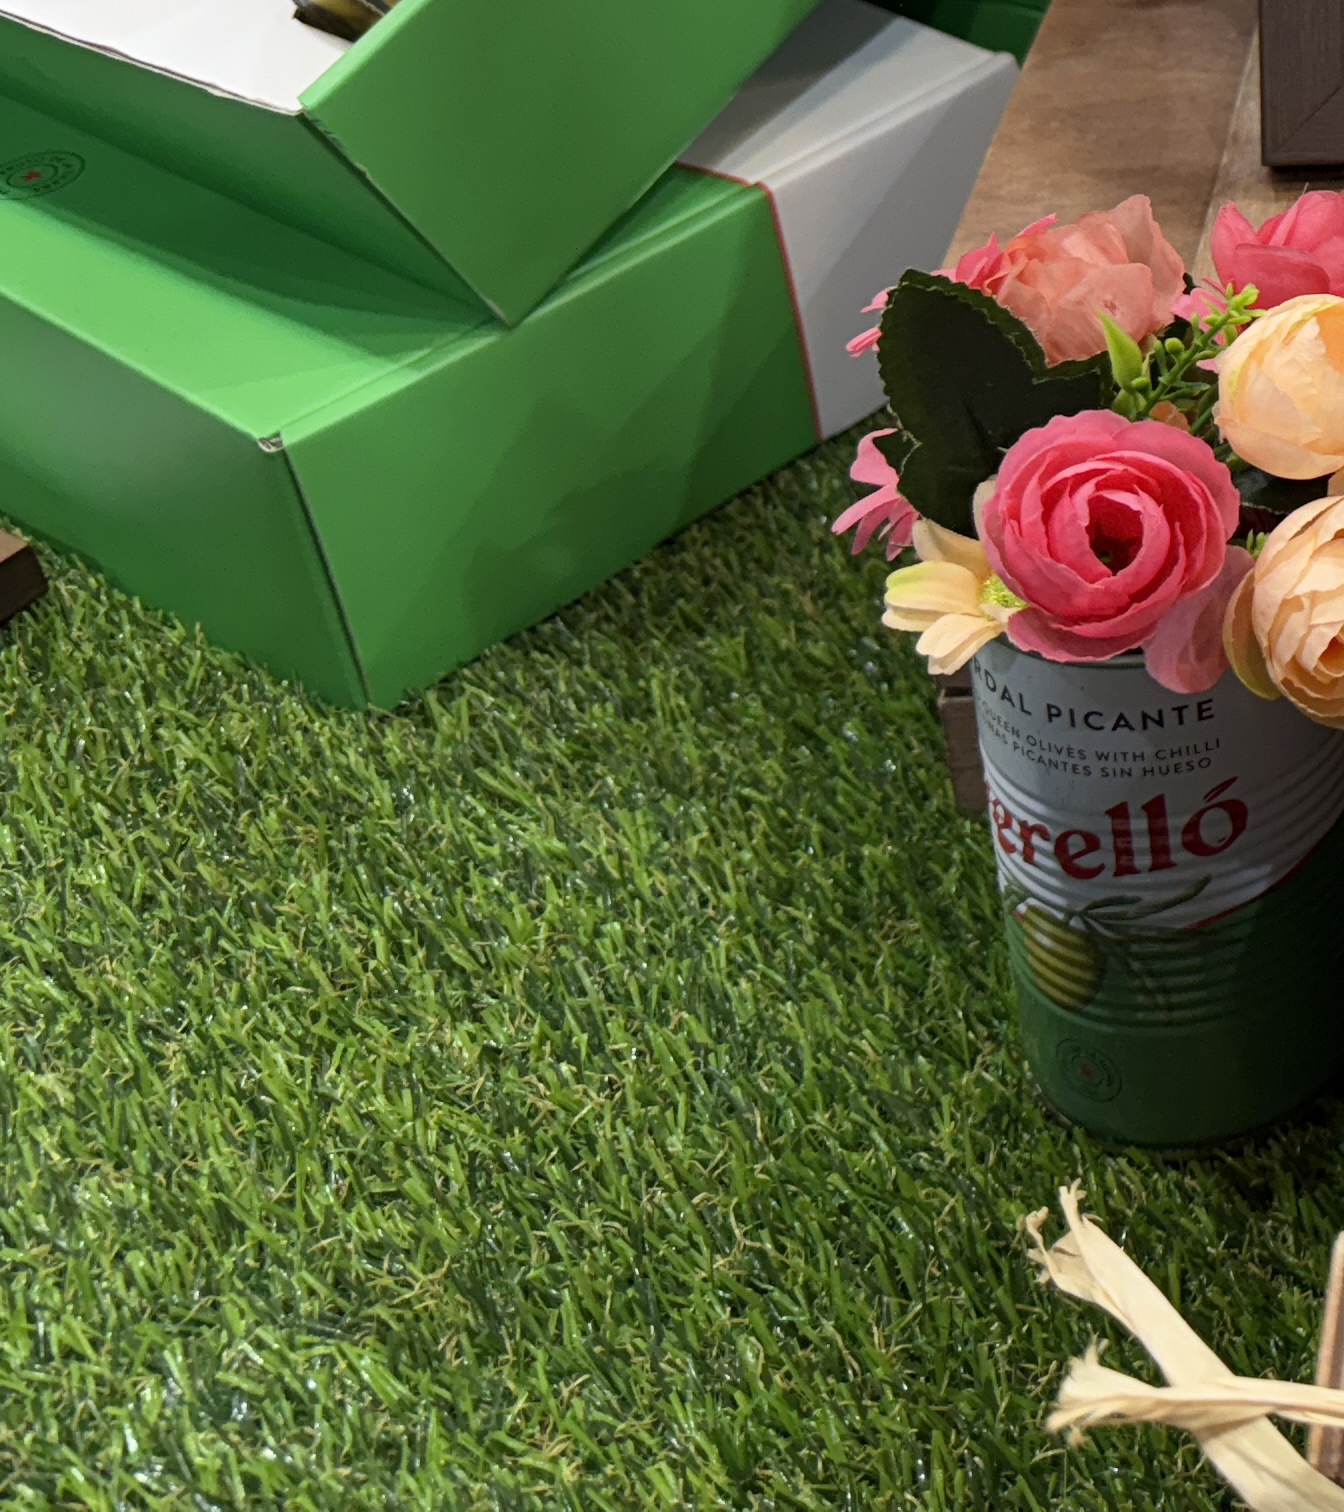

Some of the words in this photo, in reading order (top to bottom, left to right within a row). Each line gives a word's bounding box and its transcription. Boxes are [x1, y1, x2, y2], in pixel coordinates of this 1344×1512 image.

[1046, 698, 1216, 733] PICANTE
[1012, 742, 1092, 778] PICANTES
[1142, 756, 1212, 777] HUESO
[1026, 736, 1087, 762] OLIVES
[1095, 748, 1145, 762] WITH
[1154, 738, 1221, 760] CHILLI
[988, 776, 1248, 879] erelló
